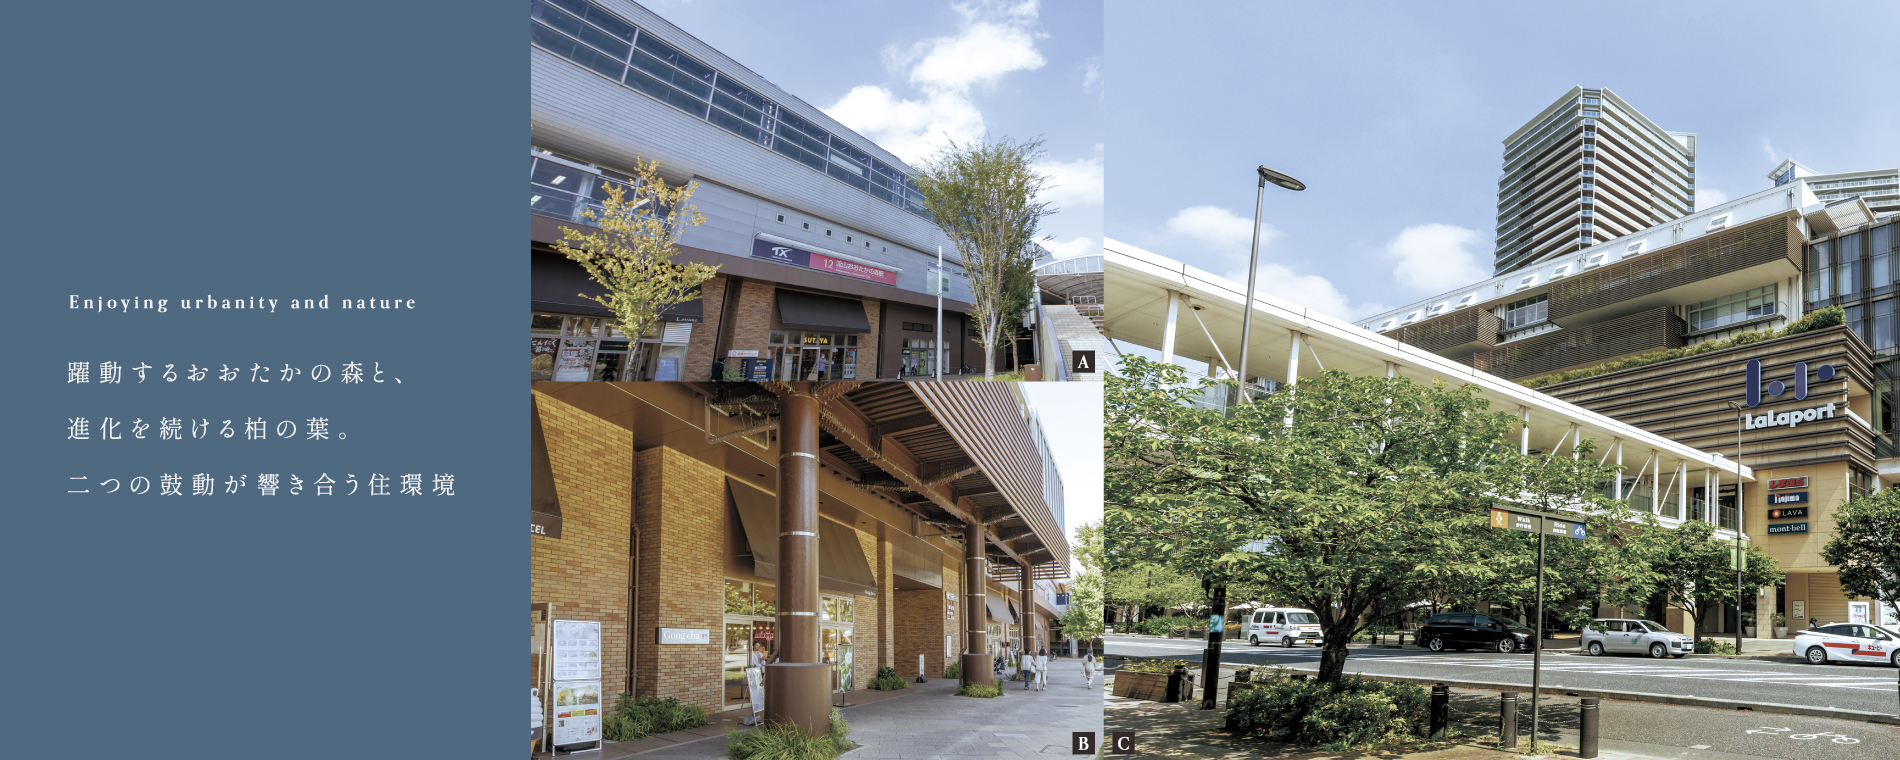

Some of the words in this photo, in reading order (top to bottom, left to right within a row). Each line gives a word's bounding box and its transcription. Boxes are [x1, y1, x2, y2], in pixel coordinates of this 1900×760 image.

[771, 246, 793, 258] TX
[823, 258, 833, 270] 12
[1745, 402, 1836, 430] LaLaport
[1782, 509, 1803, 517] LAVA
[1516, 515, 1531, 524] Walk
[1553, 521, 1566, 529] Ride
[663, 630, 686, 642] Gong
[686, 630, 700, 640] cha
